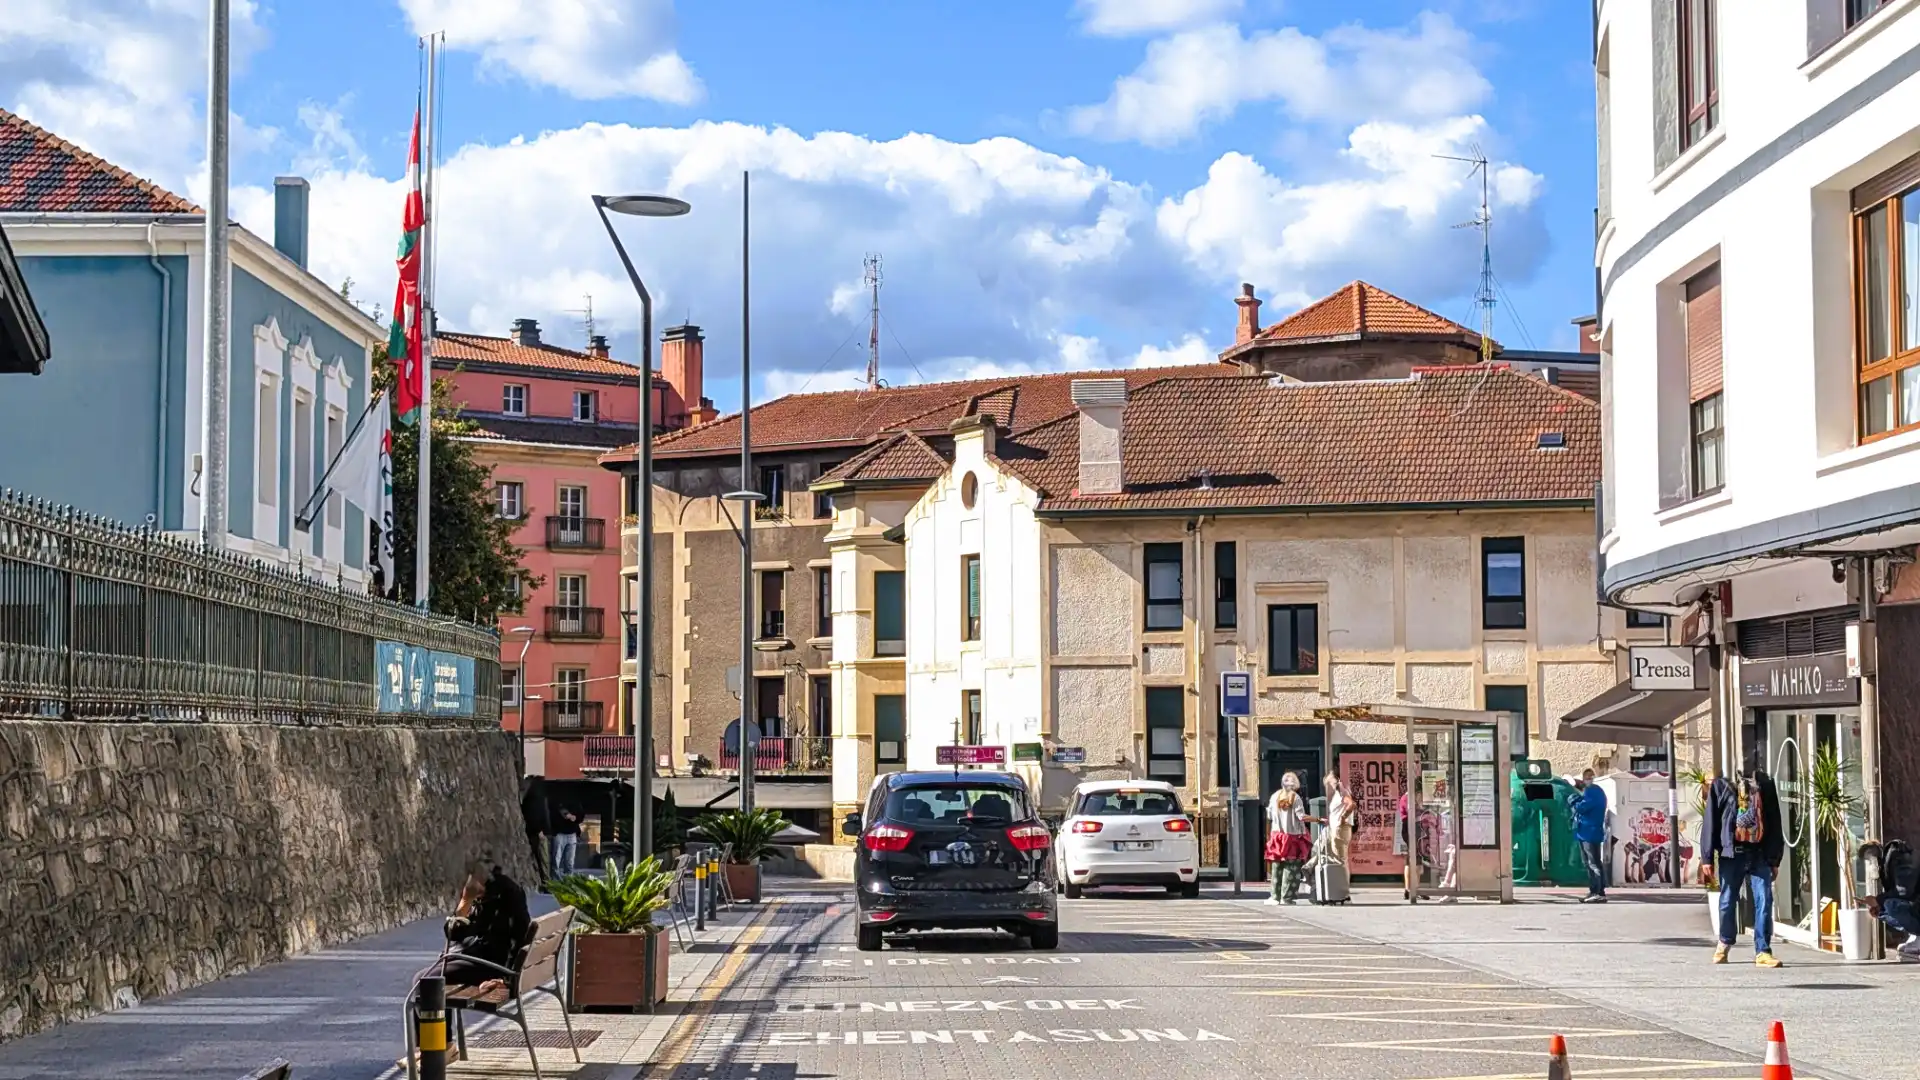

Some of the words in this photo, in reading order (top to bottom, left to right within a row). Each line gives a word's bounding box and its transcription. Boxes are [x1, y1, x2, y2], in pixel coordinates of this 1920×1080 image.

[1634, 656, 1691, 678] Prensa
[1366, 761, 1396, 783] QR
[1366, 785, 1390, 798] QUE
